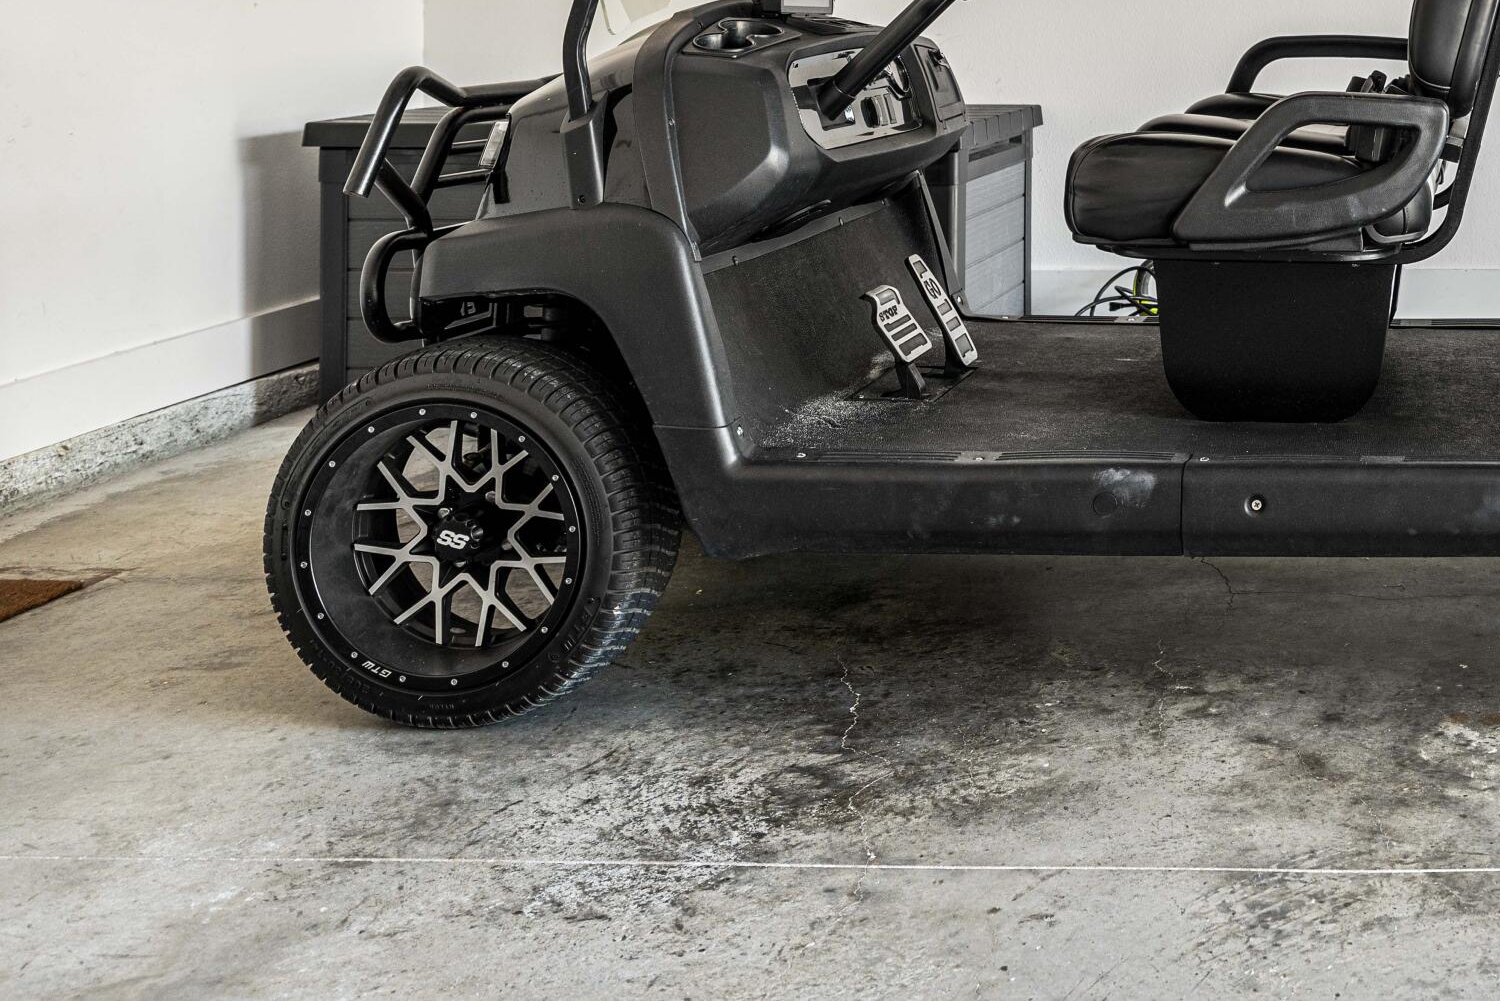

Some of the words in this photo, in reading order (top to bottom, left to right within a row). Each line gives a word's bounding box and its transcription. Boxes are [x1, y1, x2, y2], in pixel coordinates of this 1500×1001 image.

[923, 278, 942, 299] GO
[879, 305, 898, 322] STOP
[436, 529, 470, 550] SS
[361, 660, 392, 678] GTW
